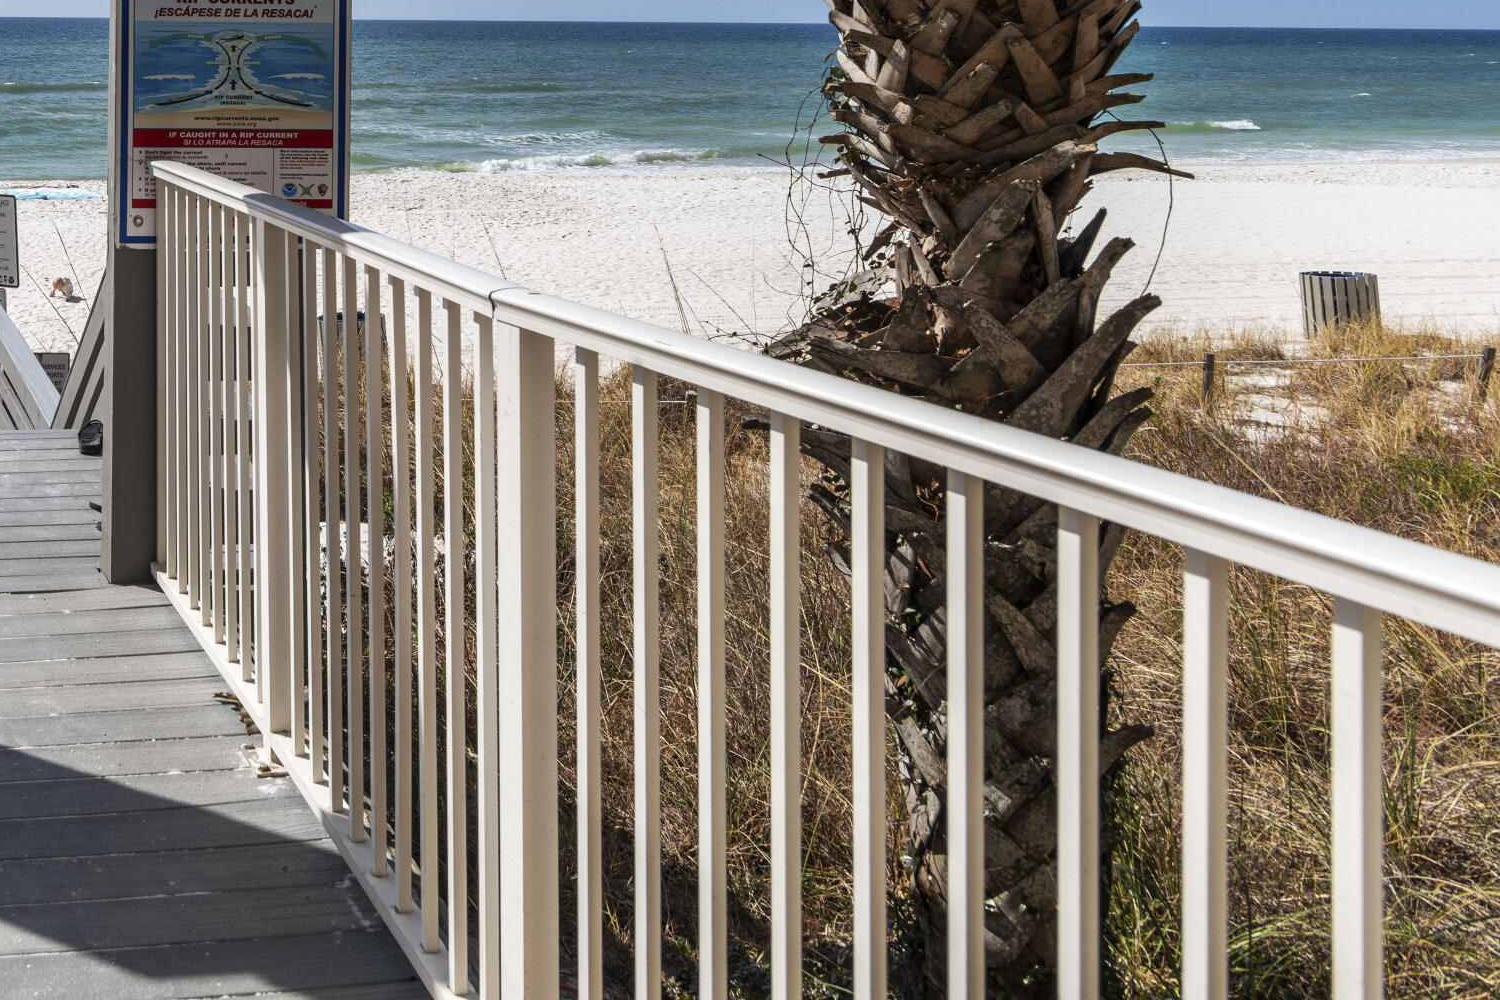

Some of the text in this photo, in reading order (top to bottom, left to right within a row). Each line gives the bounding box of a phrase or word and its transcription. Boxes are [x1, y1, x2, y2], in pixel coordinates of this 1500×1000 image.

[224, 7, 240, 18] DE
[243, 8, 258, 19] LA
[261, 8, 313, 19] RESACA!
